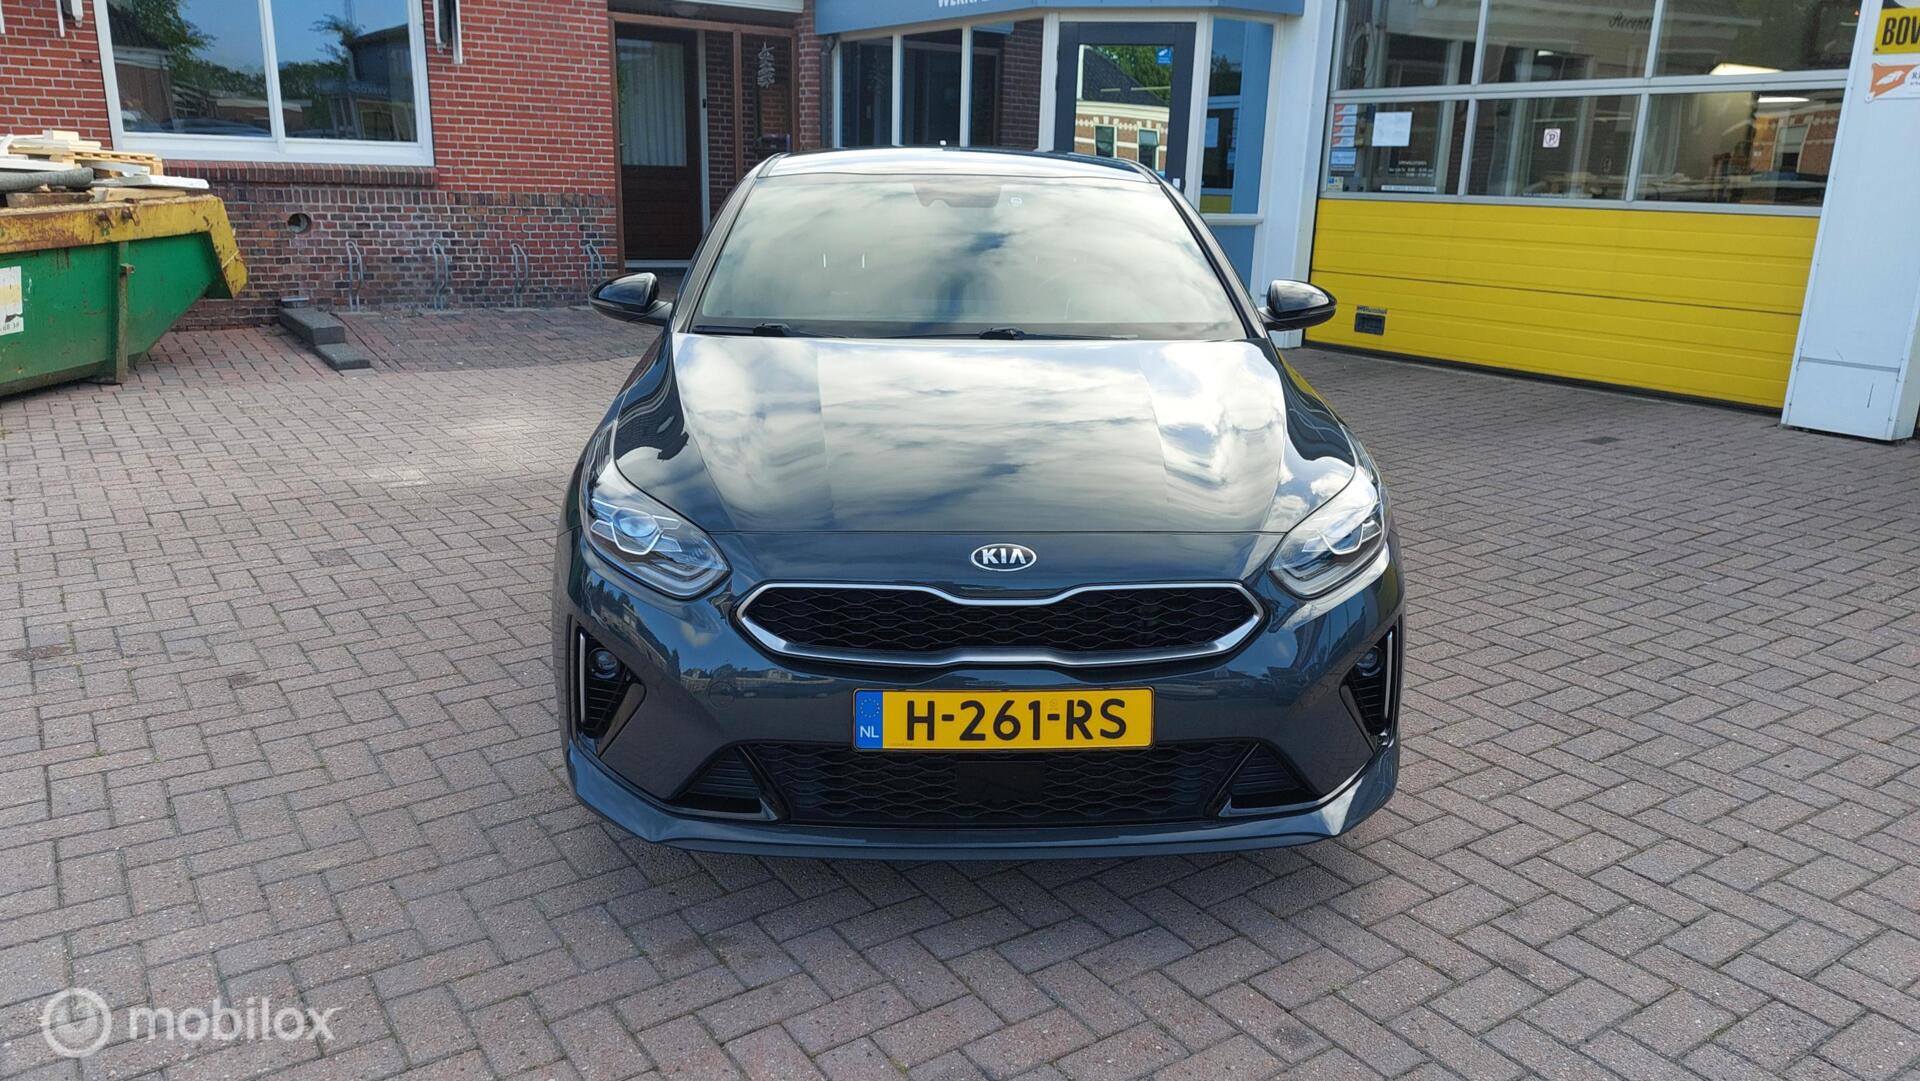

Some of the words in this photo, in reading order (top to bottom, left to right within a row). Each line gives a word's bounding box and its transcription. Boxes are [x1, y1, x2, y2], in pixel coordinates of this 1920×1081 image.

[982, 547, 1027, 565] KIA
[906, 698, 1127, 741] H-261-RS
[859, 725, 879, 738] NL
